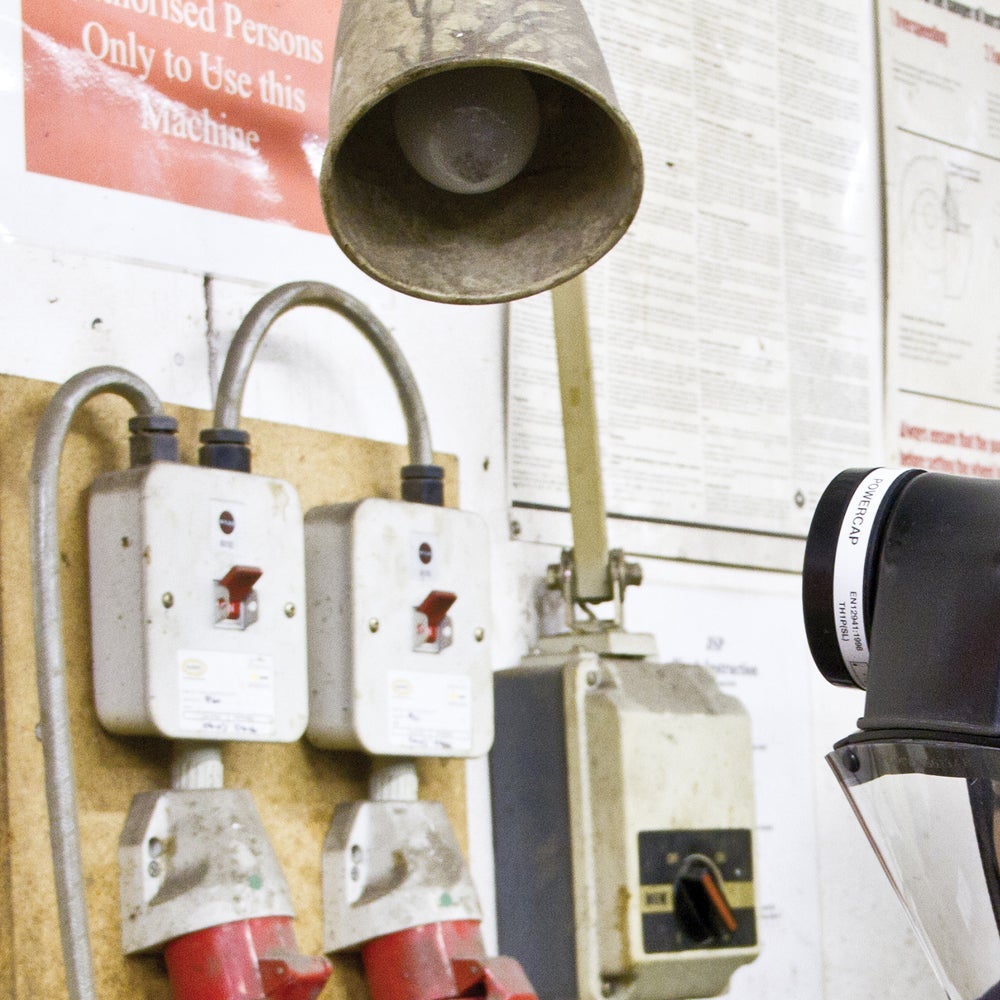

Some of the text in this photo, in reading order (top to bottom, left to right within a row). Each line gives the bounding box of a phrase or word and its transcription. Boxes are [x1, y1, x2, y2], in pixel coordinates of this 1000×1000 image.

[223, 2, 324, 64] Persons
[82, 21, 306, 113] Only to Use this
[140, 99, 260, 154] Machine
[848, 478, 883, 546] POWERCAP
